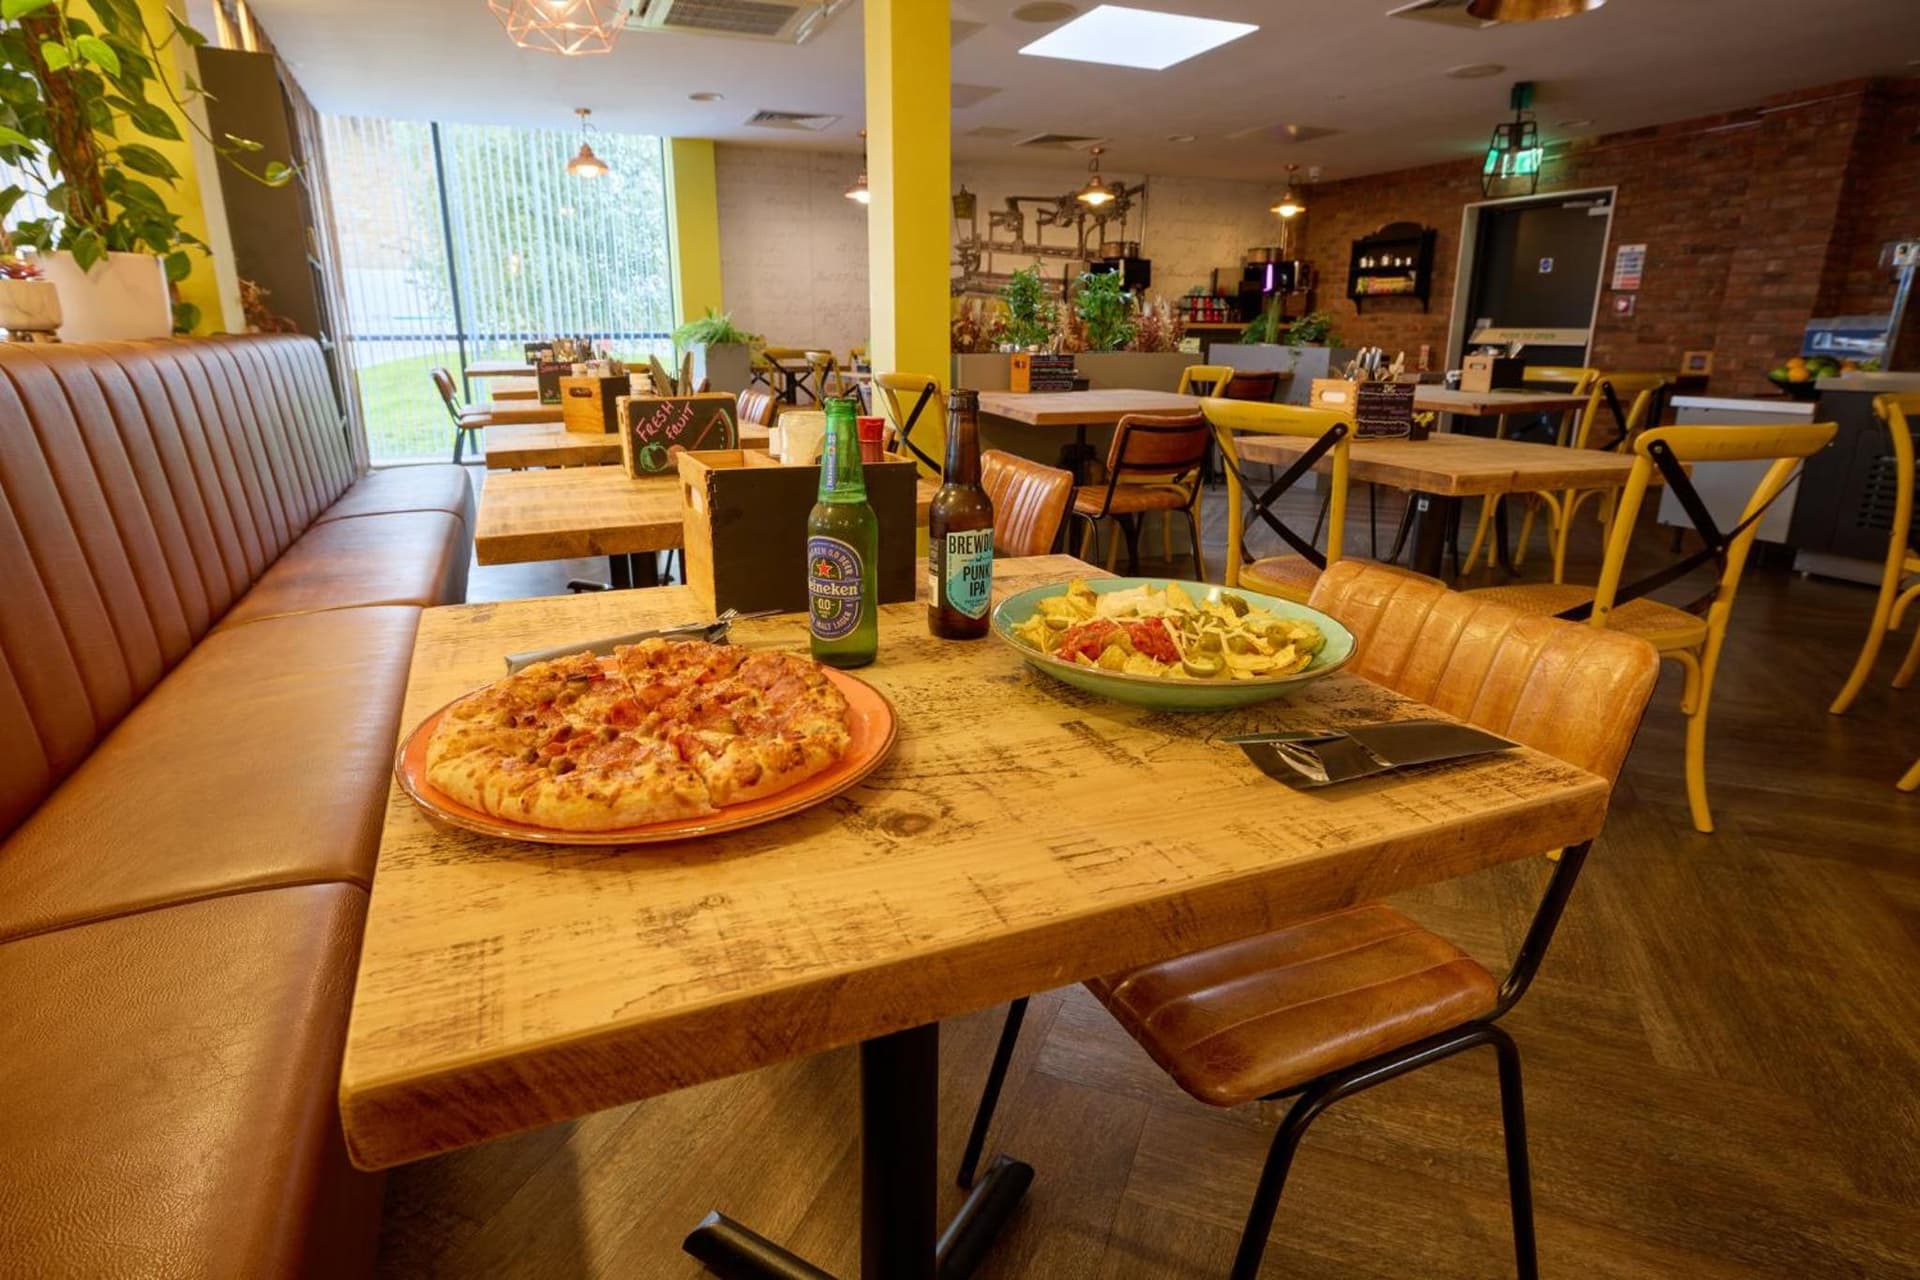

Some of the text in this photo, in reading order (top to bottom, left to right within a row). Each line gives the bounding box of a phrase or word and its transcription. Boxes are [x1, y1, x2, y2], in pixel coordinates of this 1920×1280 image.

[635, 400, 674, 443] FRESH
[665, 401, 694, 440] FRUIT
[963, 563, 991, 581] PUNK
[809, 582, 858, 596] eineken
[969, 581, 986, 597] IPA
